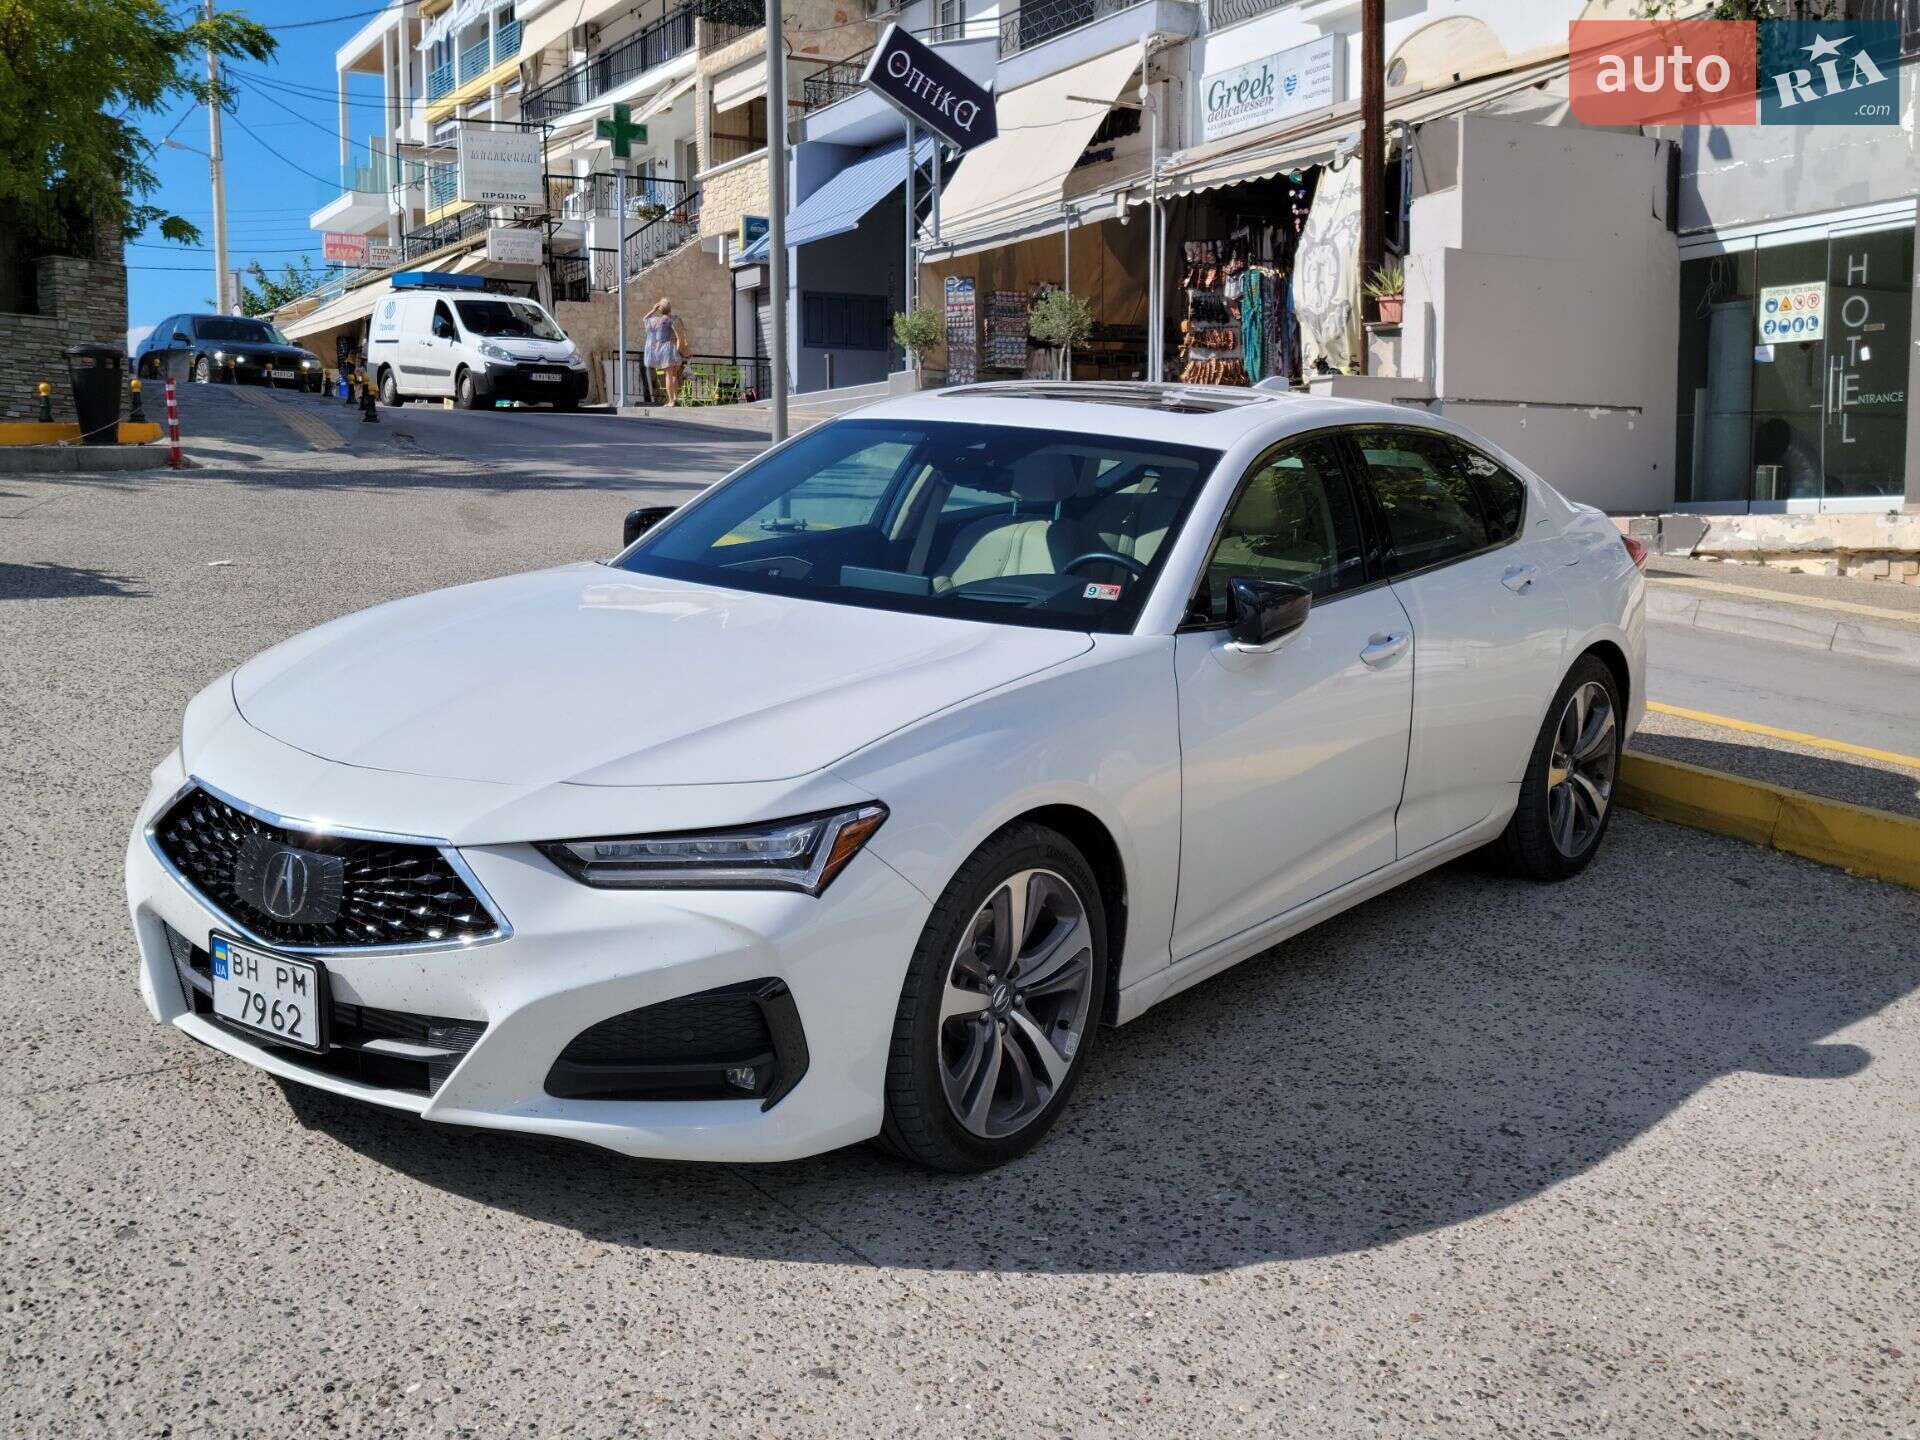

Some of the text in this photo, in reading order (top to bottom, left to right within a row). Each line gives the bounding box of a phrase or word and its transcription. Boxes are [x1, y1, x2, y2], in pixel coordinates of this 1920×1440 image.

[1208, 64, 1274, 113] Greek
[481, 191, 527, 201] ΠΡΩΙΝΟ
[1842, 252, 1869, 443] HOTEL
[1088, 586, 1097, 596] 9
[215, 962, 227, 978] UA
[232, 952, 306, 996] BH PM
[238, 986, 302, 1038] 7962
